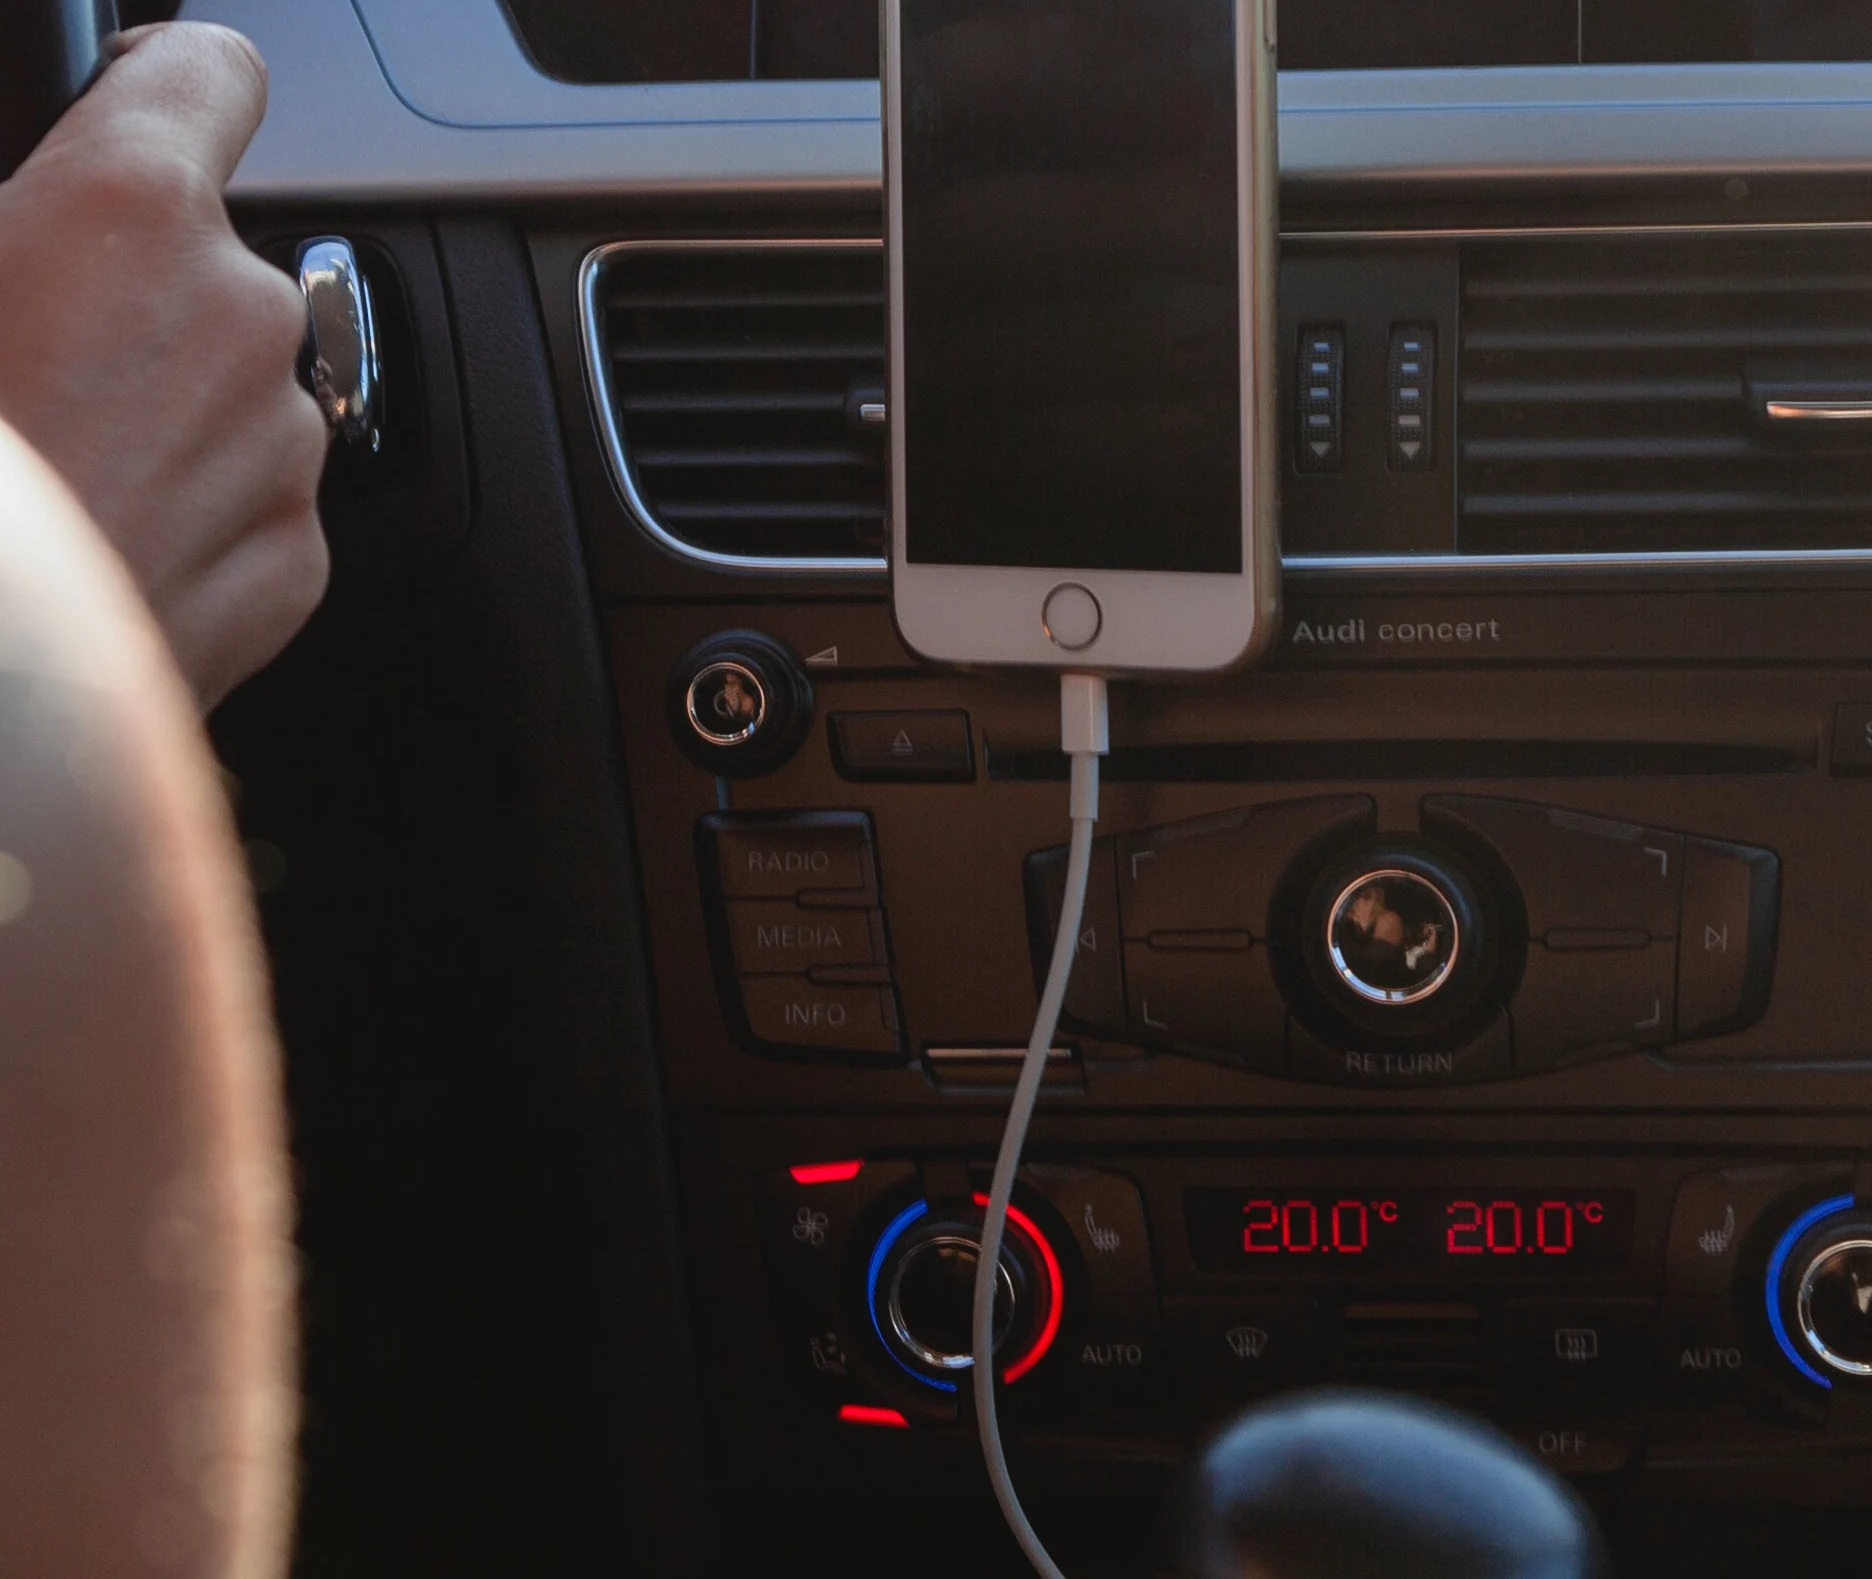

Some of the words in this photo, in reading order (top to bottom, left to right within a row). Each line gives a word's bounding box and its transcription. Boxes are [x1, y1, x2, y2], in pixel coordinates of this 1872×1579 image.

[1292, 618, 1366, 643] Audi
[1378, 619, 1500, 642] concert
[747, 851, 830, 875] RADIO
[756, 924, 842, 948] MEDIA
[784, 1002, 846, 1026] INFO
[1345, 1049, 1454, 1075] RETURN
[1080, 1342, 1144, 1367] AUTO
[1679, 1346, 1742, 1370] AUTO
[1538, 1431, 1588, 1456] OFF
